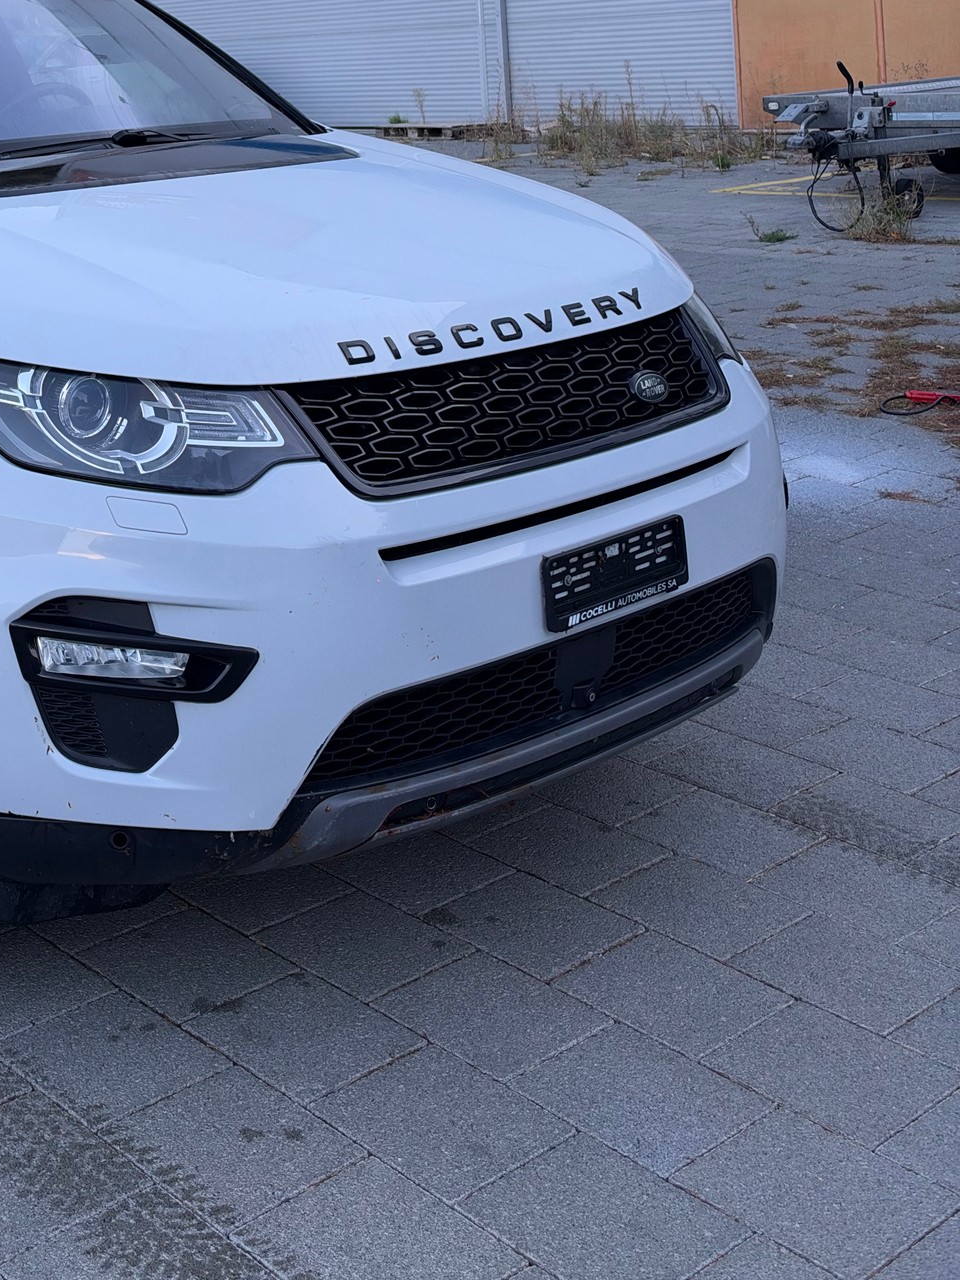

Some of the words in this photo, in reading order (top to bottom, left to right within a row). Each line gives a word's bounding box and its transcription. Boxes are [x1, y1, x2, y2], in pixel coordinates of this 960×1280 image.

[337, 287, 642, 366] DISCOVERY
[640, 377, 658, 390] LAND
[645, 384, 665, 397] ROVER
[581, 600, 615, 621] COCELLI
[616, 581, 666, 607] AUTOMOBILES
[667, 578, 677, 589] SA
